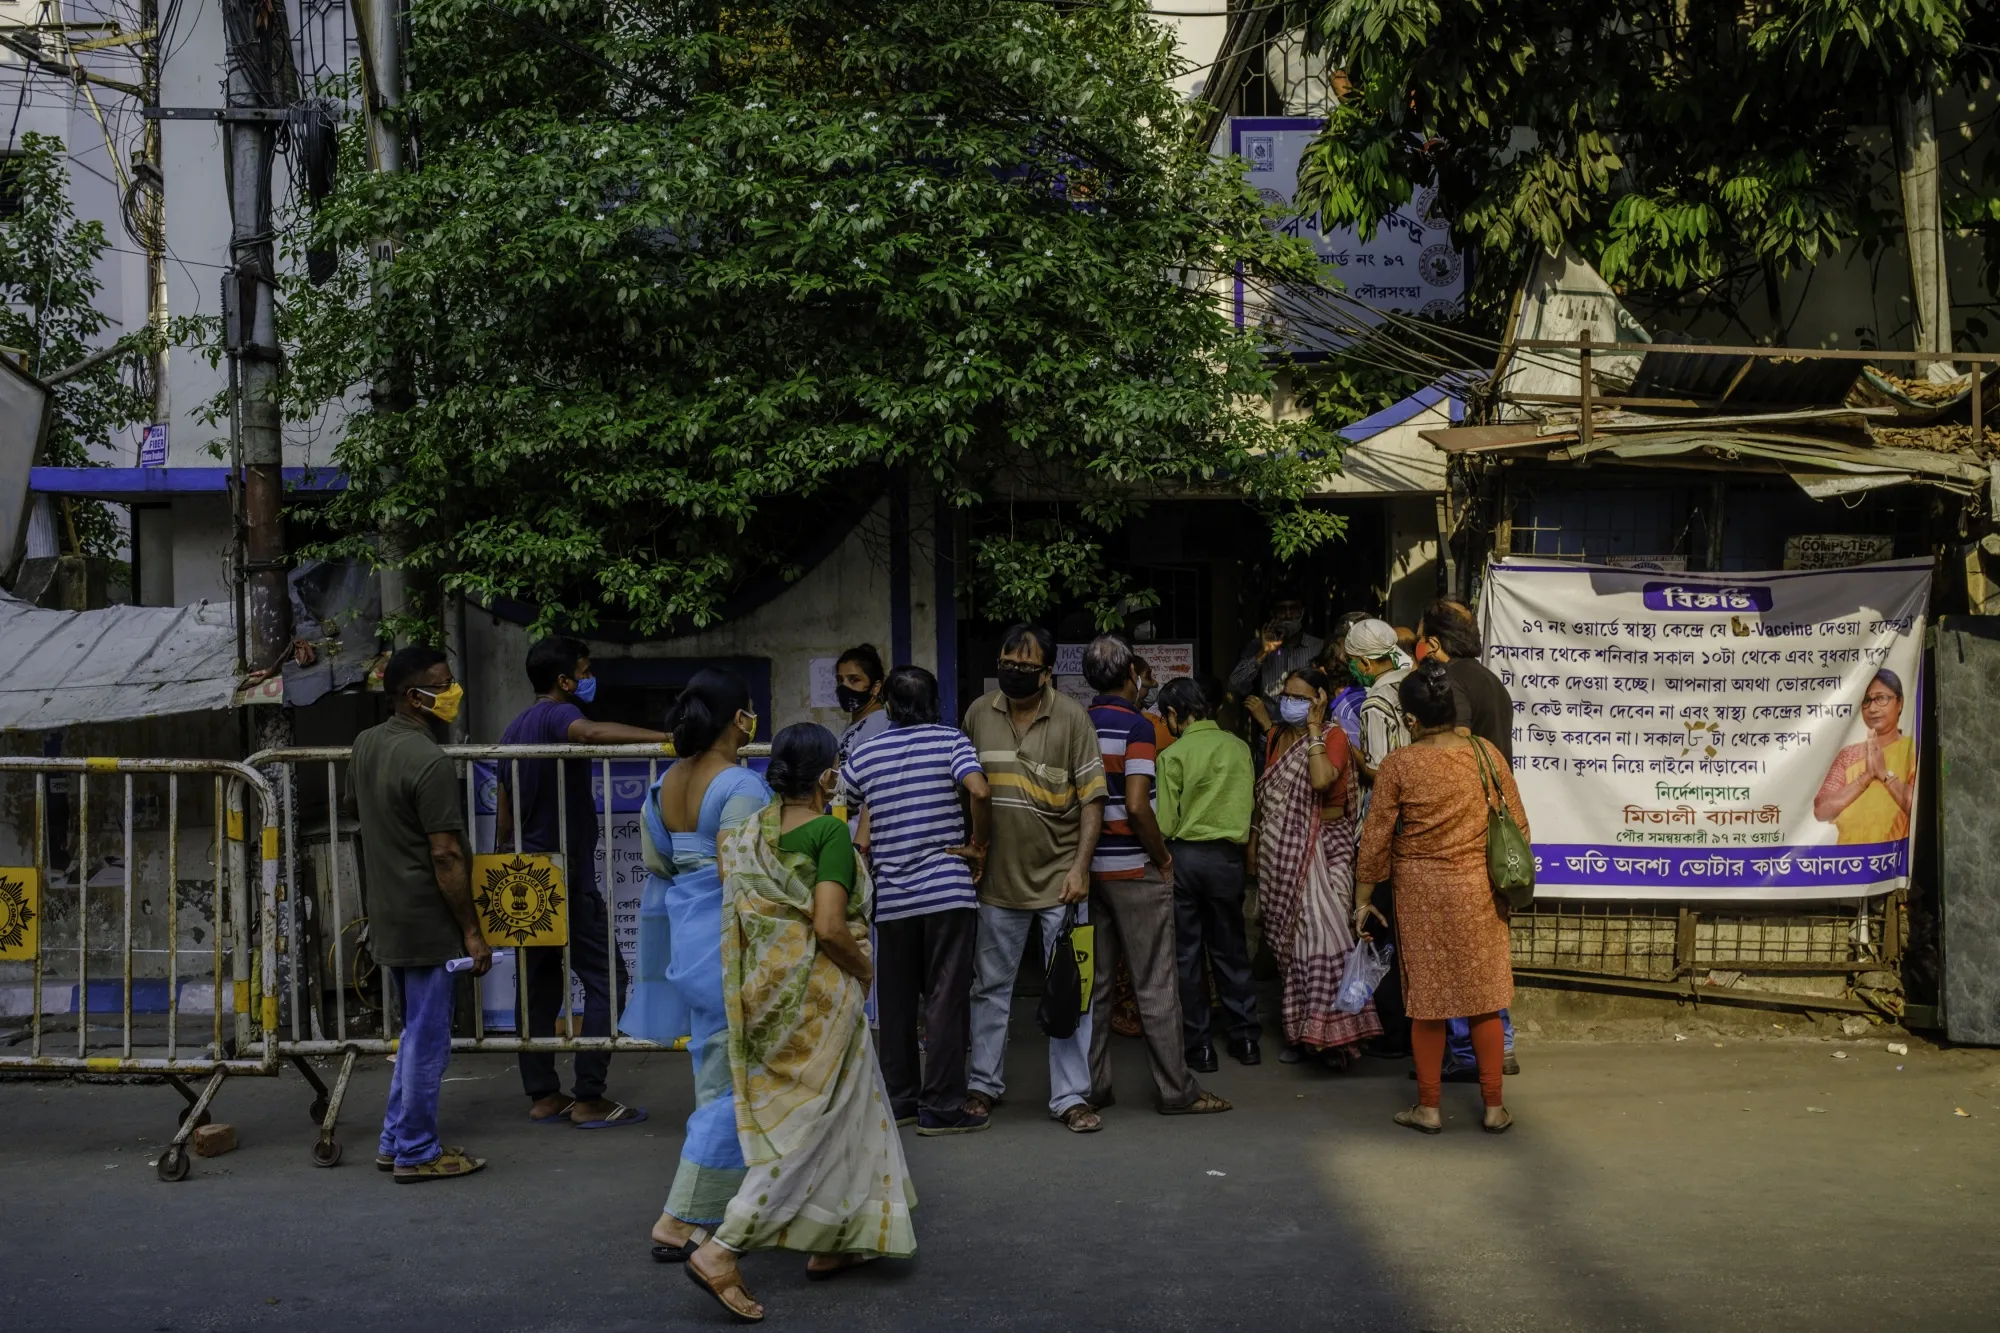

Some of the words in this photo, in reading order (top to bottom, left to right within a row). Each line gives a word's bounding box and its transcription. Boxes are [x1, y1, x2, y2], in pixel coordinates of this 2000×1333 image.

[1355, 254, 1375, 267] নং
[1383, 255, 1404, 266] ৯৭
[1355, 284, 1421, 299] পৌরসংস্থা
[1801, 540, 1875, 552] COMPUTER
[1662, 587, 1751, 609] বিজ্ঞপ্তি
[1522, 619, 1543, 633] ৯৭
[1548, 620, 1566, 634] নং
[1571, 618, 1620, 637] ওয়ার্ডে
[1623, 622, 1656, 640] স্বাস্থ্য
[1663, 623, 1703, 638] কেন্দ্রে
[1710, 624, 1726, 637] যে
[1750, 622, 1813, 637] -Vaccine
[1819, 621, 1860, 636] দেওয়া
[1062, 647, 1084, 659] MAS
[1490, 645, 1544, 661] সোমবার
[1551, 647, 1591, 662] থেকে
[1595, 645, 1648, 664] শনিবার
[1653, 650, 1694, 665] সকাল
[1702, 648, 1735, 665] ১০টা
[1742, 649, 1781, 664] থেকে
[1785, 651, 1813, 664] এবং
[1819, 648, 1859, 668] বুধবার
[1056, 661, 1084, 672] VACC
[1521, 673, 1559, 688] থেকে
[1565, 676, 1608, 690] দেওয়া
[1665, 677, 1726, 692] আপনারা
[1731, 678, 1770, 692] অযথা
[1776, 675, 1842, 692] ভোরবেলা
[1531, 700, 1562, 716] কেউ
[1567, 700, 1603, 719] লাইন
[1610, 705, 1654, 719] দেবেন
[1660, 705, 1674, 719] না
[1680, 706, 1709, 720] এবং
[1713, 706, 1746, 723] স্বাস্থ্য
[1753, 705, 1802, 720] কেন্দ্রের
[1806, 703, 1852, 719] সামনে
[1527, 723, 1557, 746] ভিড়
[1561, 730, 1611, 745] করবেন
[1643, 731, 1685, 746] সকাল
[1731, 732, 1770, 746] থেকে
[1773, 731, 1811, 750] কুপন
[1572, 758, 1608, 777] কুপন
[1612, 754, 1645, 773] নিয়ে
[1649, 755, 1694, 775] লাইনে
[1655, 781, 1750, 804] নির্দেশানুসারে
[1622, 805, 1697, 825] মিতালী
[1703, 805, 1782, 826] ব্যানার্জী
[1616, 829, 1644, 842] পৌর
[1648, 829, 1707, 844] সমন্বয়কারী
[1712, 834, 1729, 843] ৯৭
[1733, 833, 1746, 843] নং
[1565, 849, 1609, 875] অতি
[1612, 857, 1671, 876] অবশ্য
[1679, 853, 1745, 877] ভোটার
[1750, 852, 1791, 875] কার্ড
[1797, 856, 1864, 876] আনতে
[493, 879, 510, 913] KOLKATA
[513, 875, 540, 888] POLICE
[537, 889, 545, 913] FORCE
[8, 903, 16, 927] FORCE
